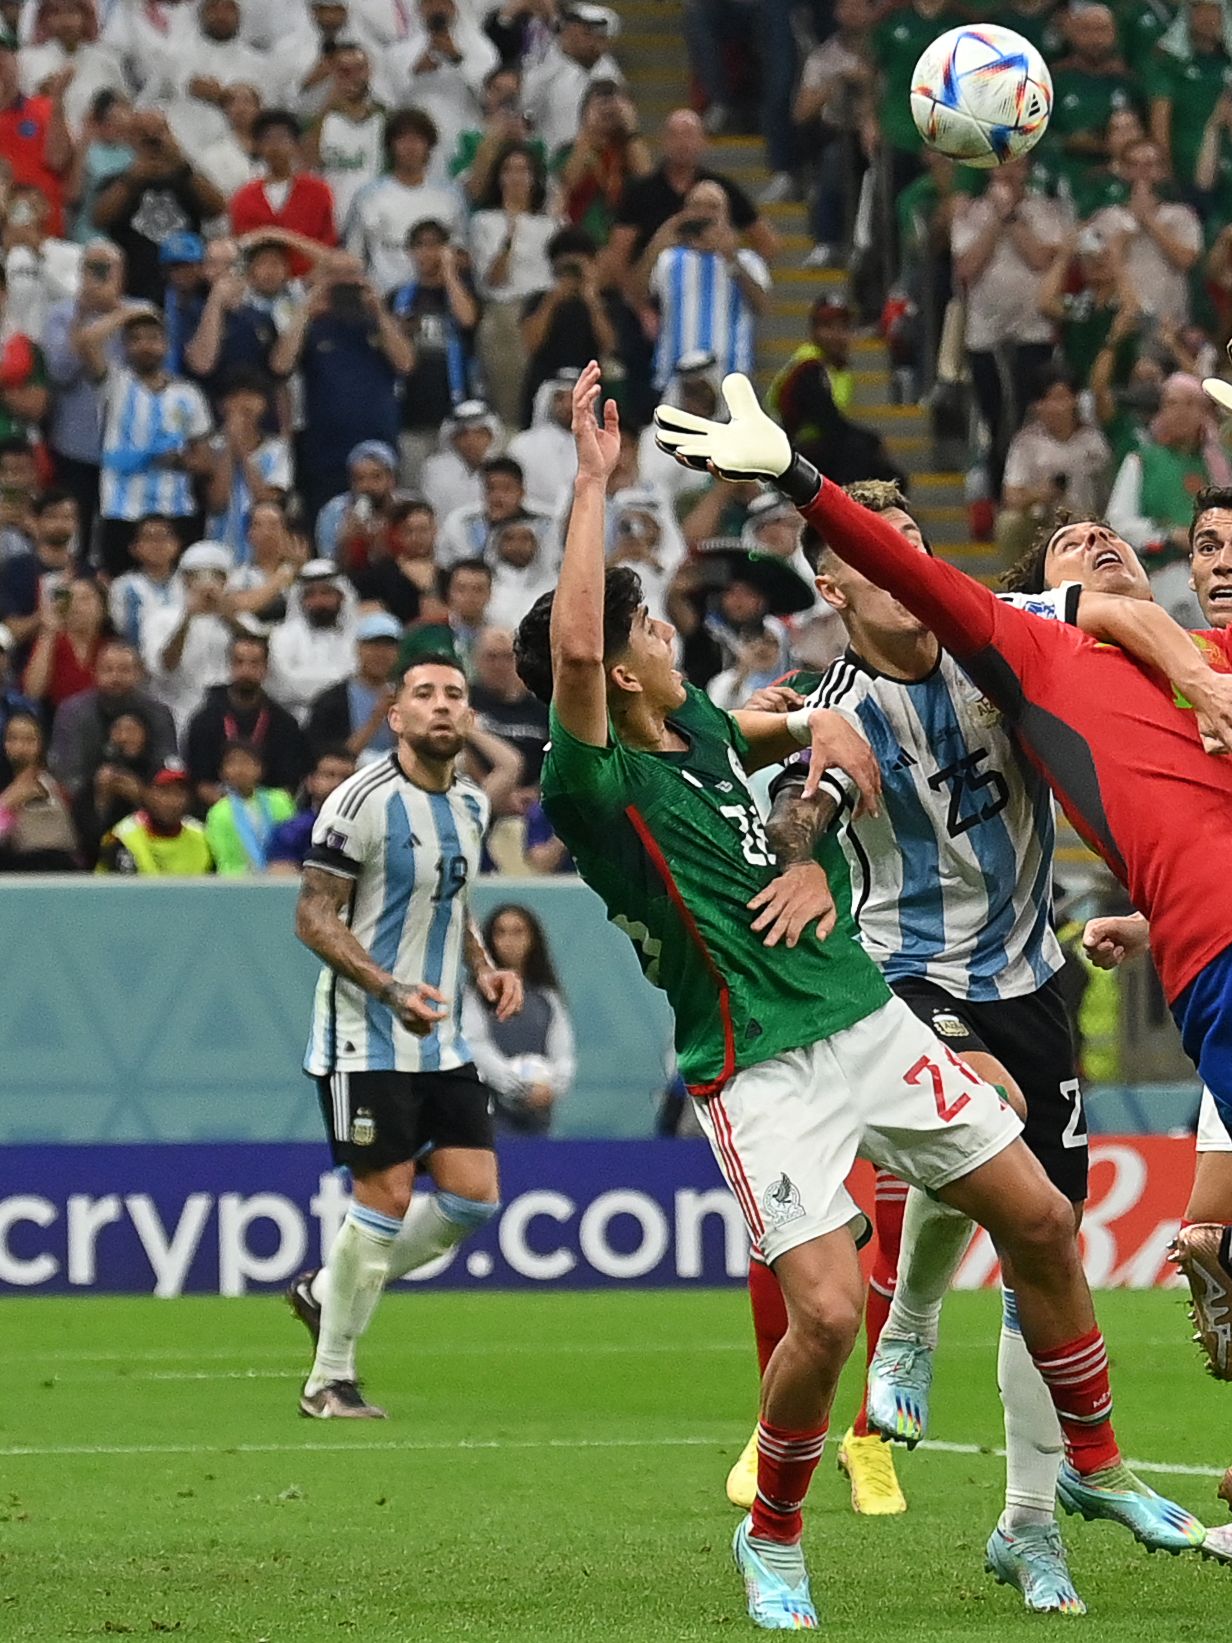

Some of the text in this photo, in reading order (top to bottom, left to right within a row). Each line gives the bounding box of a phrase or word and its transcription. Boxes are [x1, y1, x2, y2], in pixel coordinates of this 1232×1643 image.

[927, 747, 1009, 839] 25
[431, 856, 468, 903] 19
[0, 1172, 750, 1299] crypt.com
